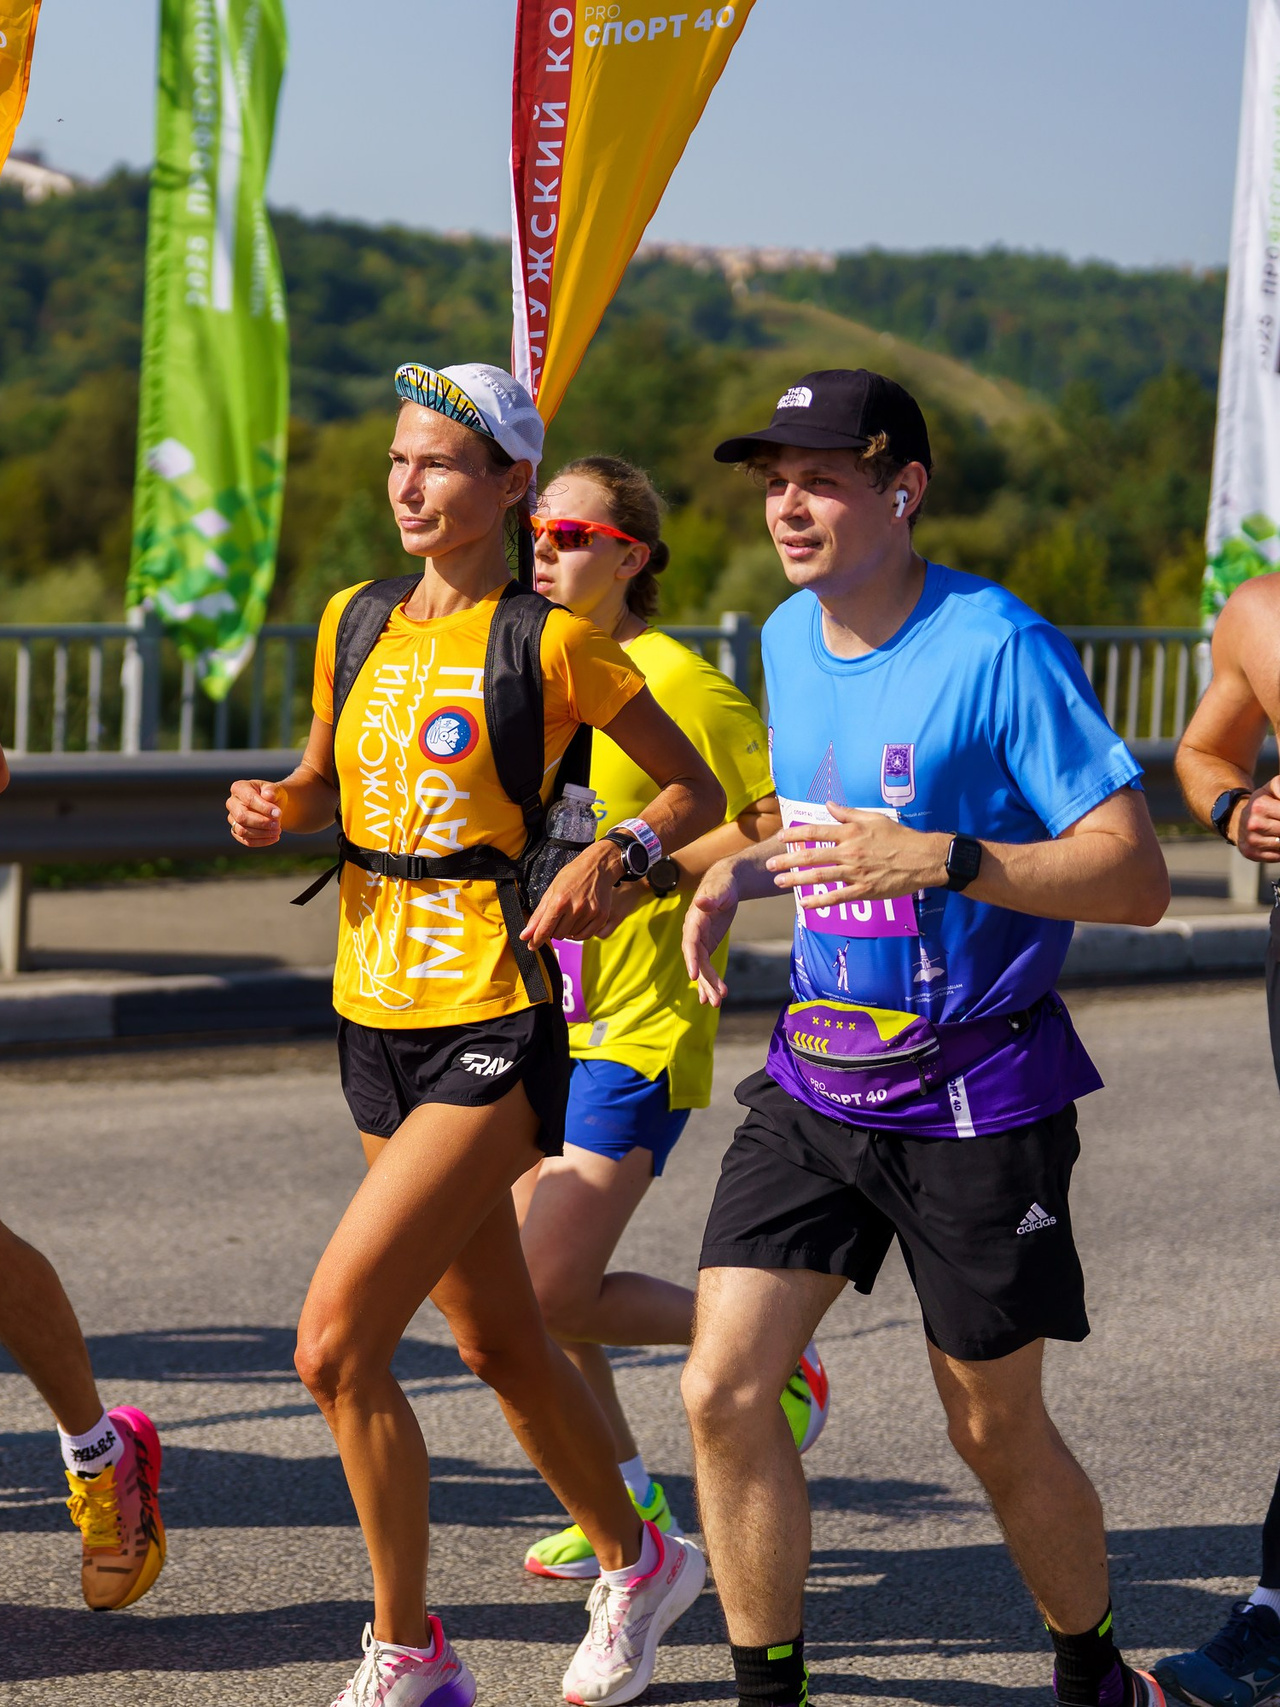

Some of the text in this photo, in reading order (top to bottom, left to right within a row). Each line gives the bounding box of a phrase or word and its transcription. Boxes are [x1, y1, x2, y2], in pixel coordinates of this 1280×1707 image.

[584, 4, 620, 21] PRO
[583, 5, 735, 48] СПОРТ 40
[545, 7, 573, 73] КО
[810, 1077, 826, 1091] PRO
[866, 1088, 888, 1104] 40
[952, 1098, 962, 1112] 40
[1016, 1216, 1057, 1235] adidas
